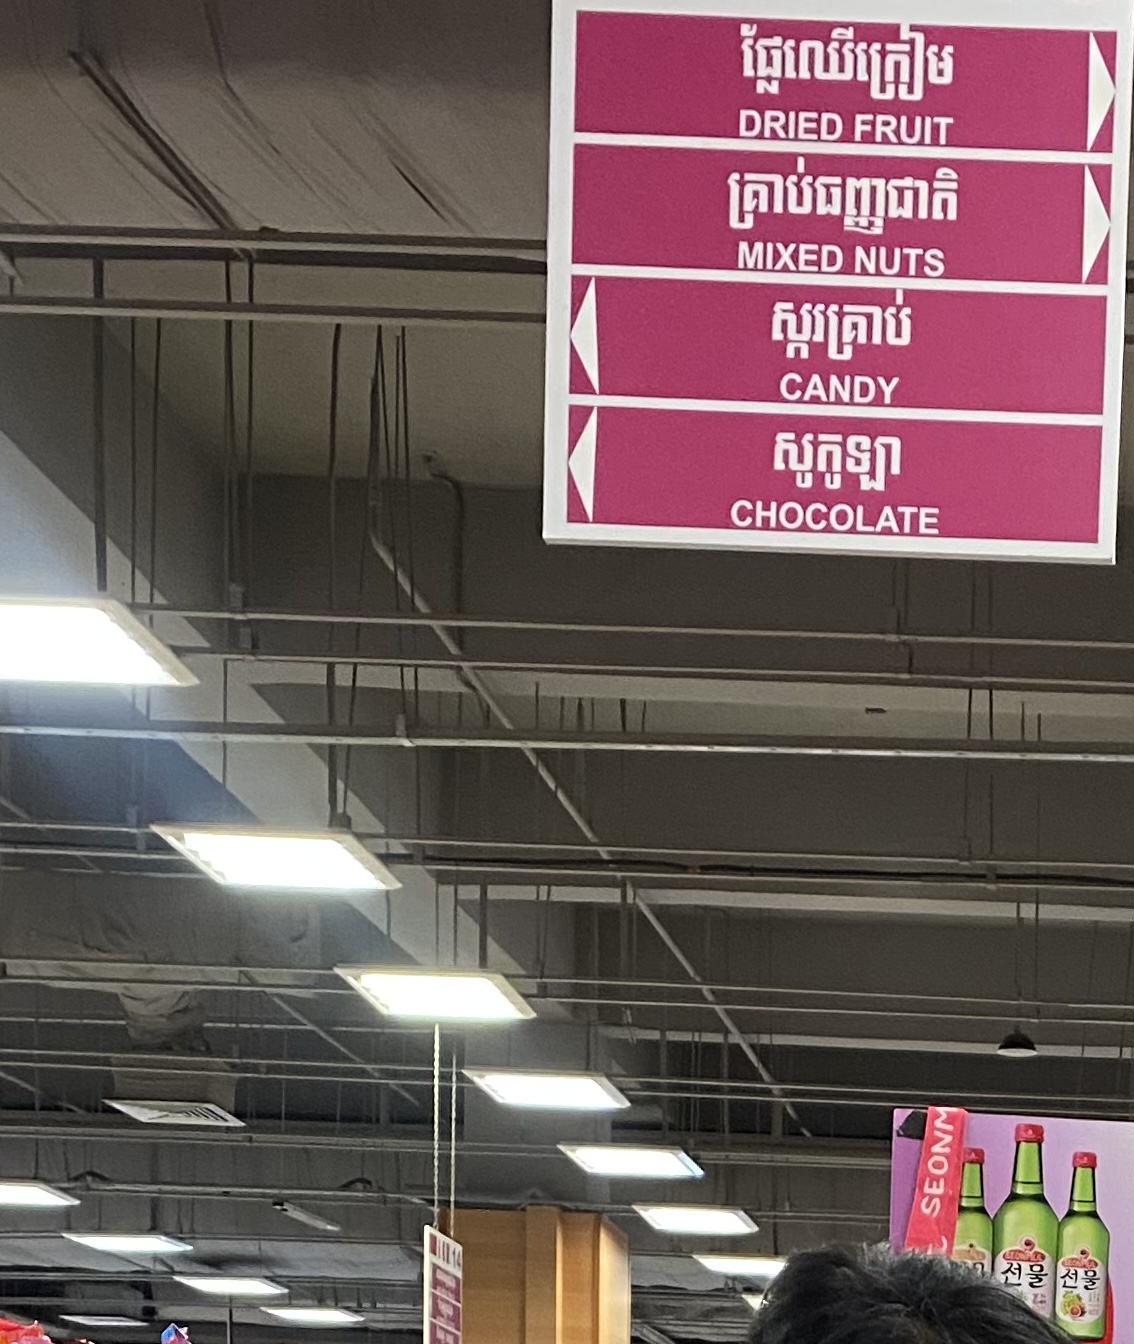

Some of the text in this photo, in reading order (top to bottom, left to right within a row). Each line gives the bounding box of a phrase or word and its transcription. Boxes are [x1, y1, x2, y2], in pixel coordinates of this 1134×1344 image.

[739, 109, 954, 145] DRIED FRUIT
[727, 156, 959, 235] គ្រាប់ធញ្ញជាតិ
[738, 241, 945, 277] MIXED NUTS
[772, 288, 912, 361] ស្ករគ្រាប់
[780, 372, 899, 405] CANDY
[773, 432, 901, 492] សូកូឡា
[730, 500, 940, 535] CHOCOLATE
